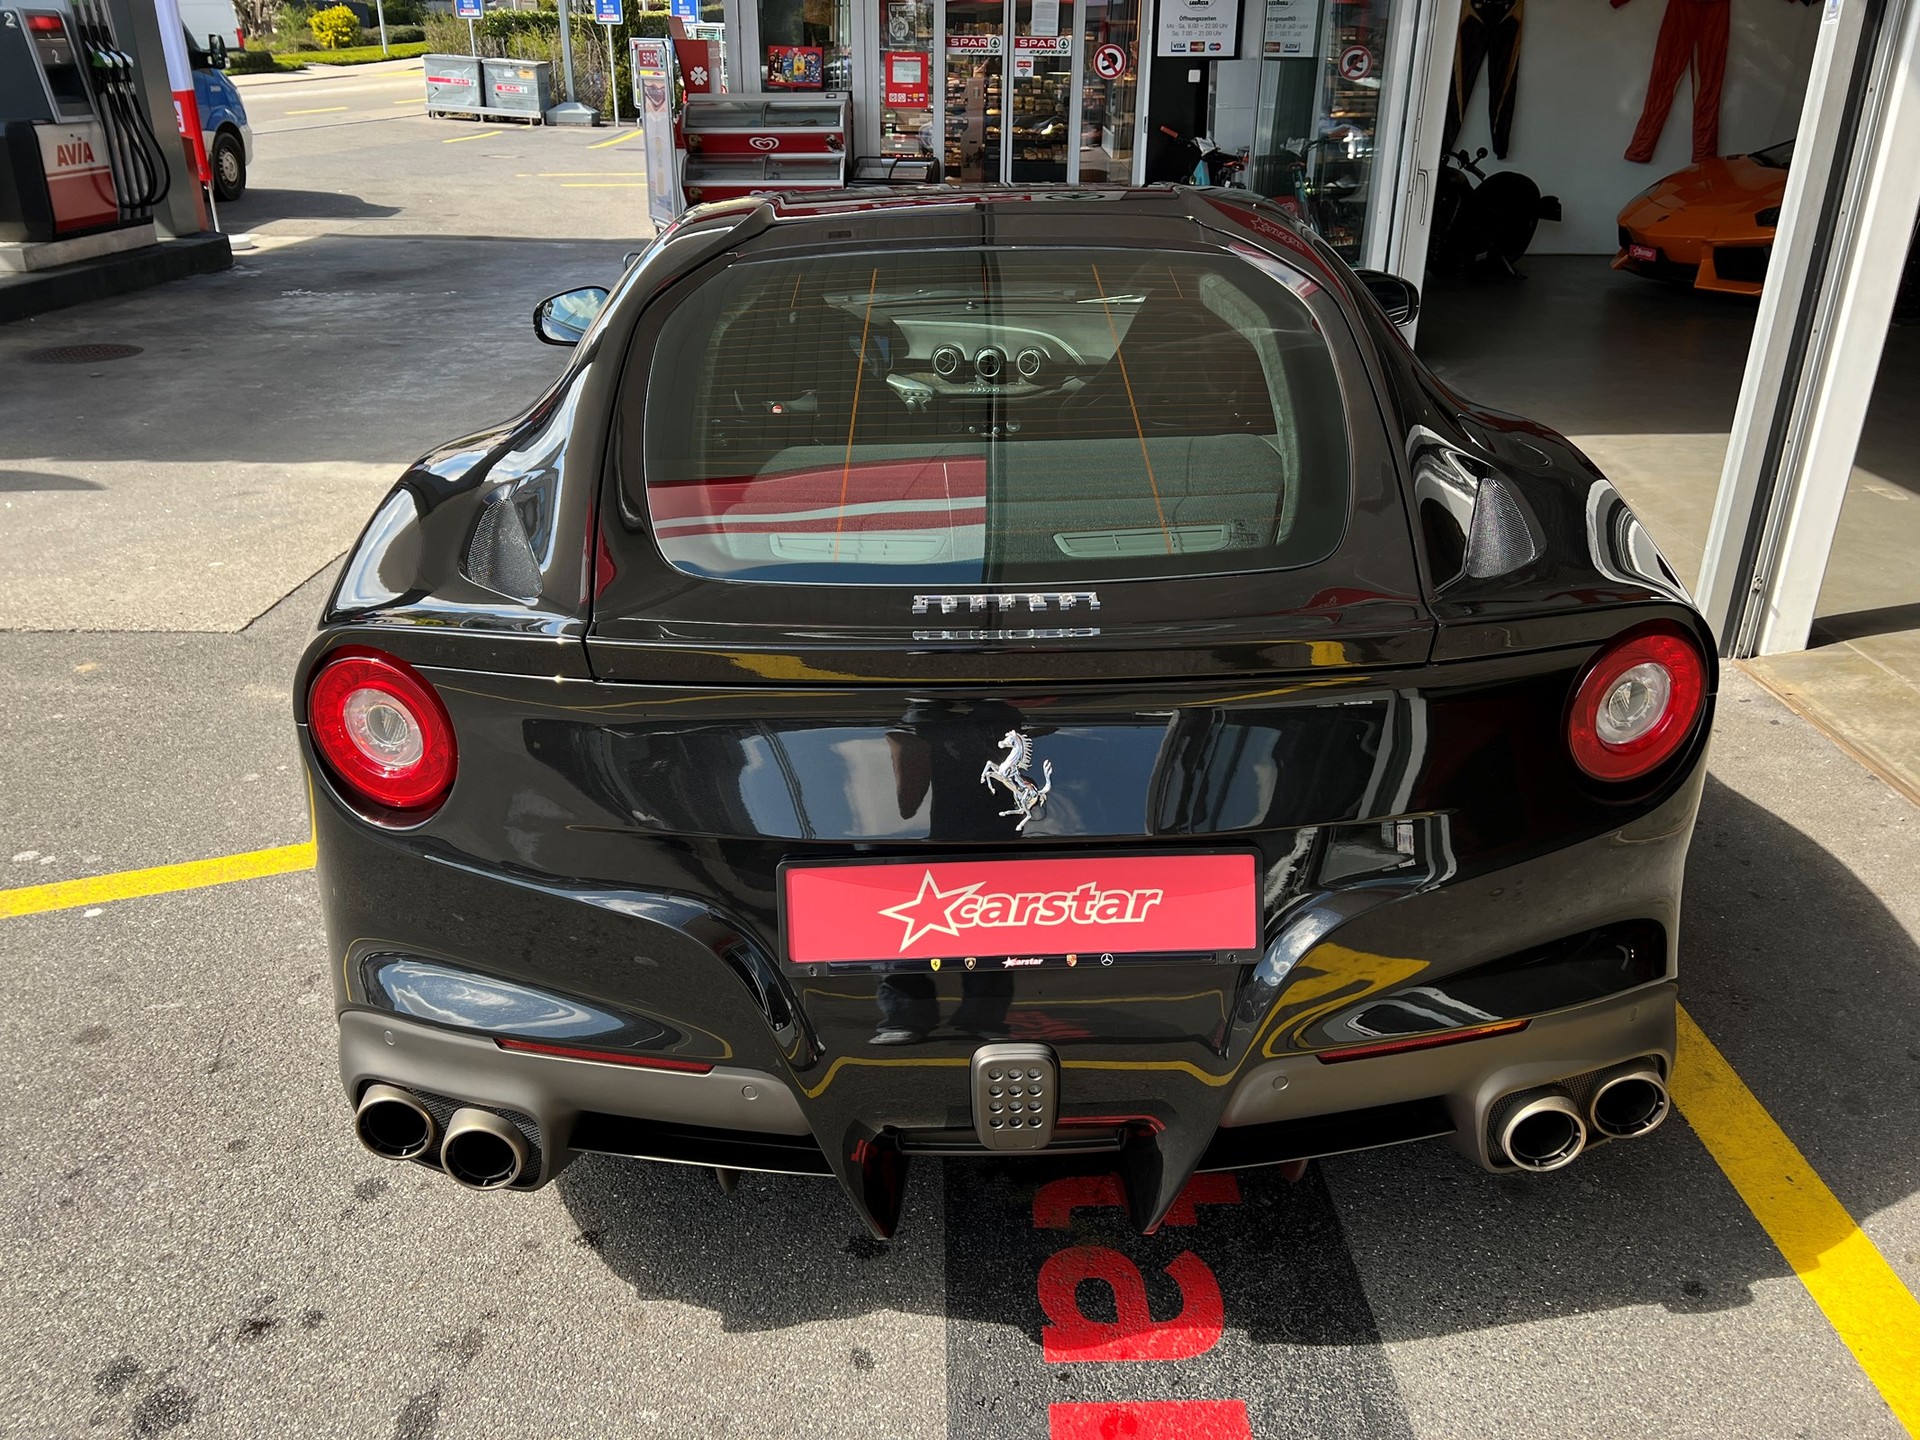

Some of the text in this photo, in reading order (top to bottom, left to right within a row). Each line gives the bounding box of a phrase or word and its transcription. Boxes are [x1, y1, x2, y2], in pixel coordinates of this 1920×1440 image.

[3, 12, 17, 28] 2
[951, 38, 987, 47] SPAR
[1020, 39, 1056, 47] SPAR
[51, 49, 61, 63] 2
[951, 880, 1164, 929] carstar
